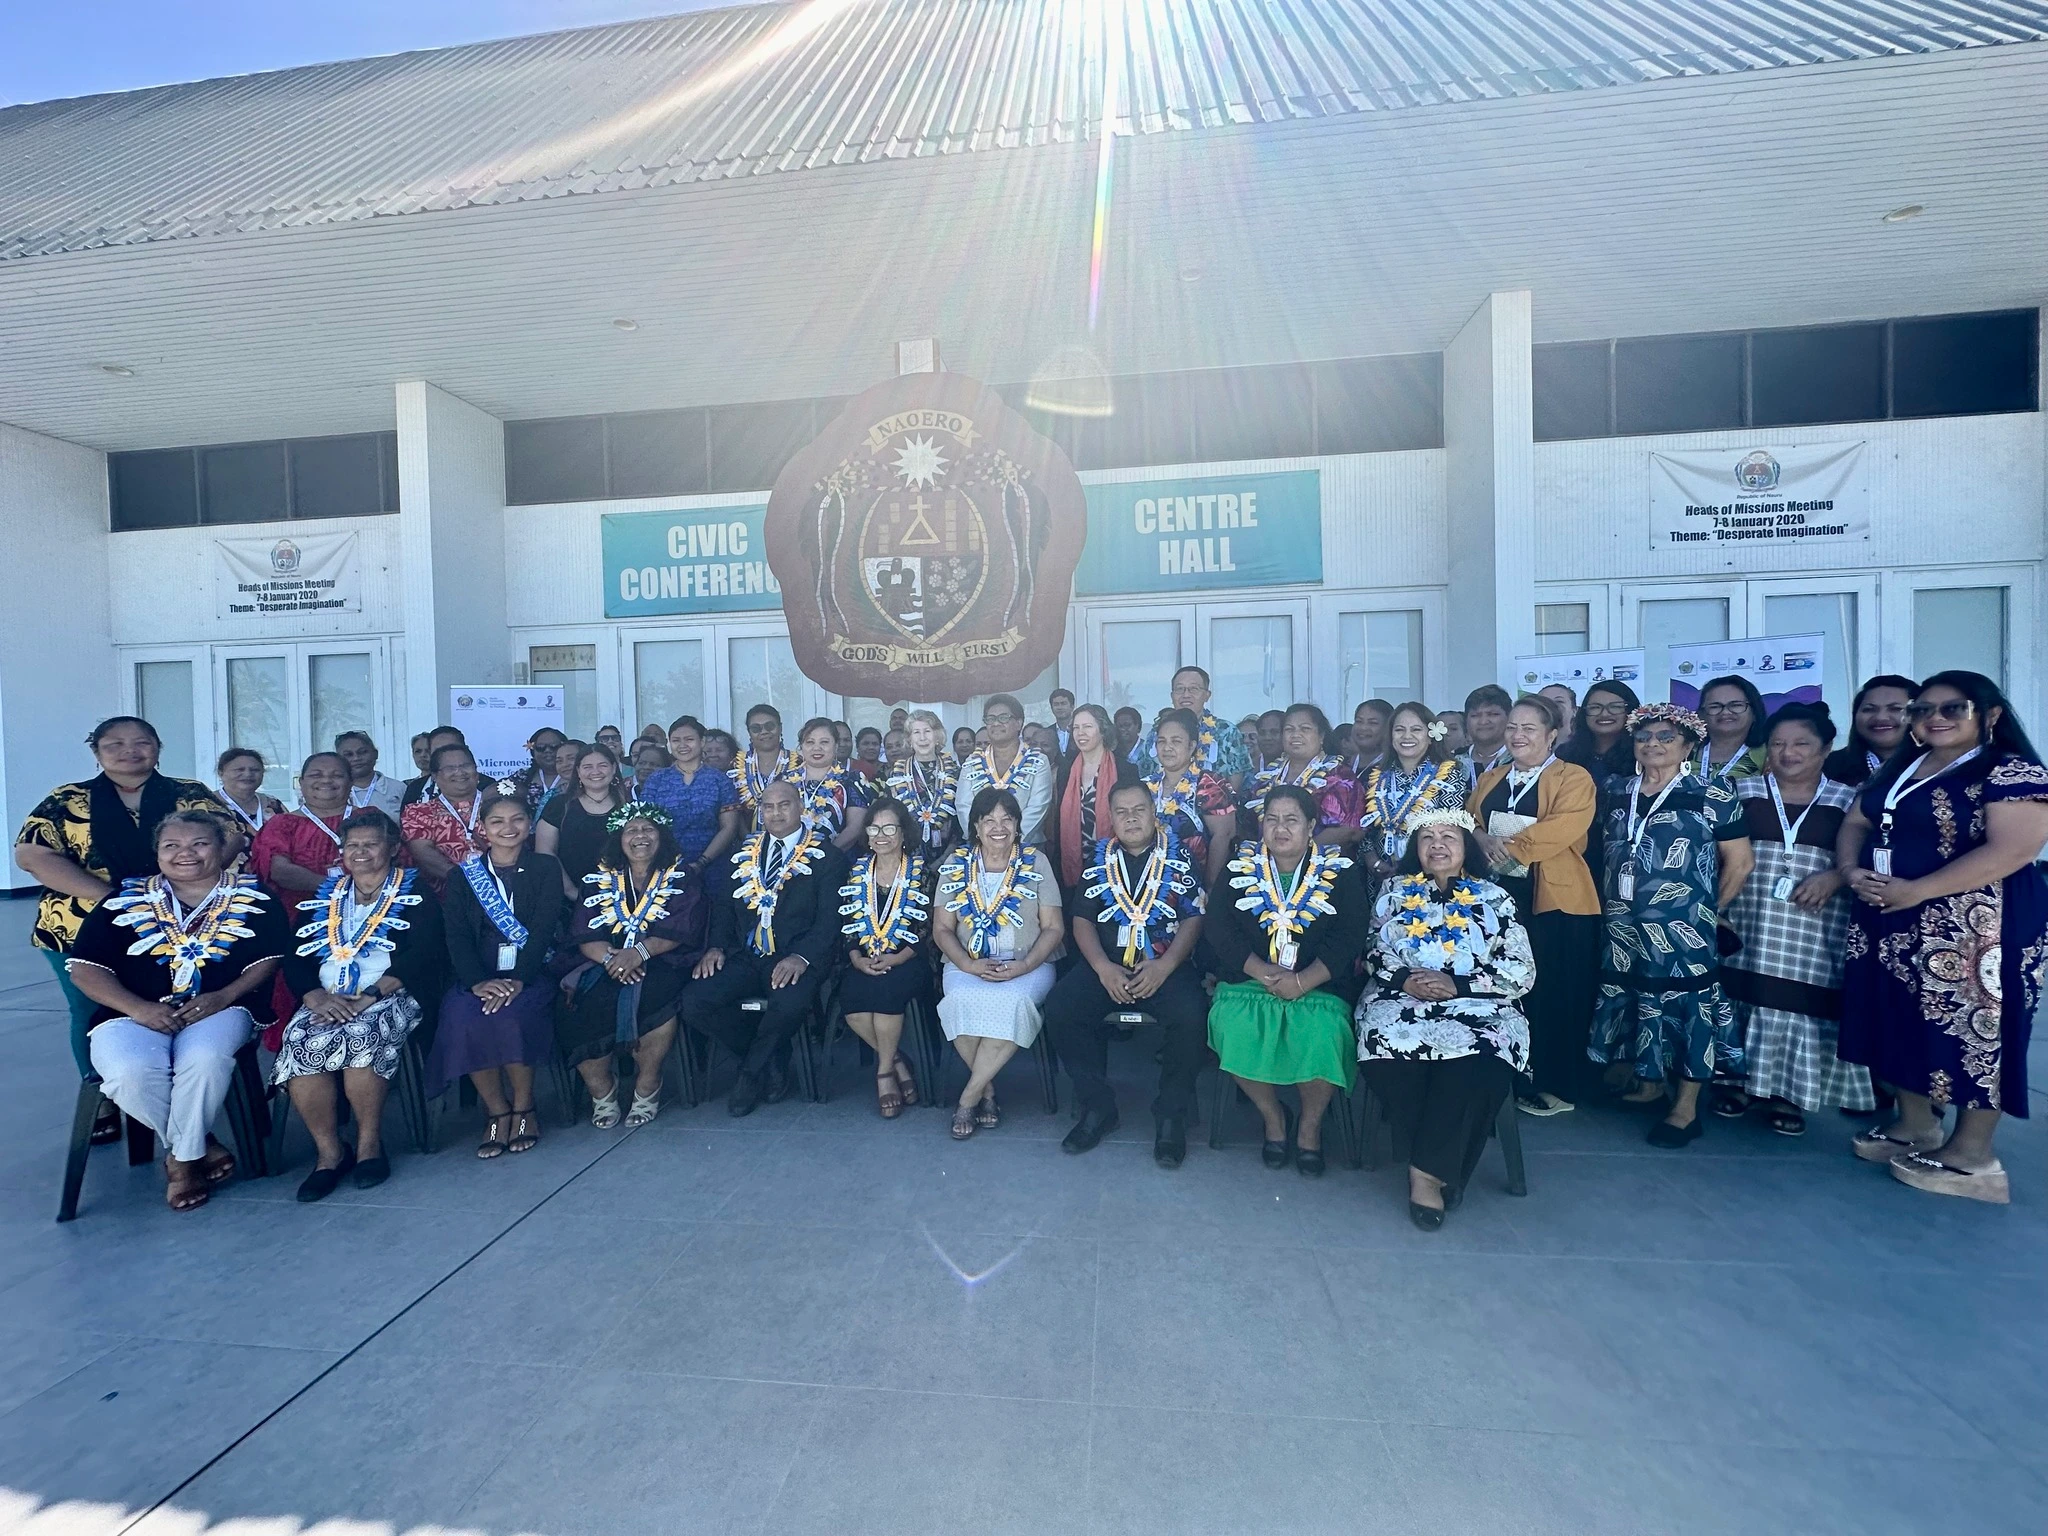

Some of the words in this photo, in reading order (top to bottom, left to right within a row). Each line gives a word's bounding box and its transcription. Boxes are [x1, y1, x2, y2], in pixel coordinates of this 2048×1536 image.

[877, 411, 963, 438] NAOERO
[1134, 492, 1258, 535] CENTRE
[1685, 504, 1719, 517] Heads
[1720, 503, 1733, 515] of
[1734, 501, 1785, 515] Missions
[1786, 499, 1834, 513] Meeting
[1713, 517, 1729, 528] 7-8
[1731, 515, 1774, 528] January
[1776, 513, 1805, 526] 2020
[667, 521, 748, 559] CIVIC
[1670, 531, 1711, 542] Theme:
[1159, 536, 1236, 575] HALL
[238, 582, 261, 592] Heads
[262, 582, 270, 591] of
[270, 580, 304, 591] Missions
[305, 579, 336, 589] Meeting
[257, 593, 268, 602] 7-8
[269, 591, 297, 602] January
[298, 590, 318, 600] 2020
[229, 603, 256, 613] Theme:
[841, 646, 888, 662] GOD'S
[906, 651, 944, 665] WILL
[962, 641, 1009, 658] FIRST
[478, 758, 531, 767] Micronesi
[463, 860, 497, 902] MISS
